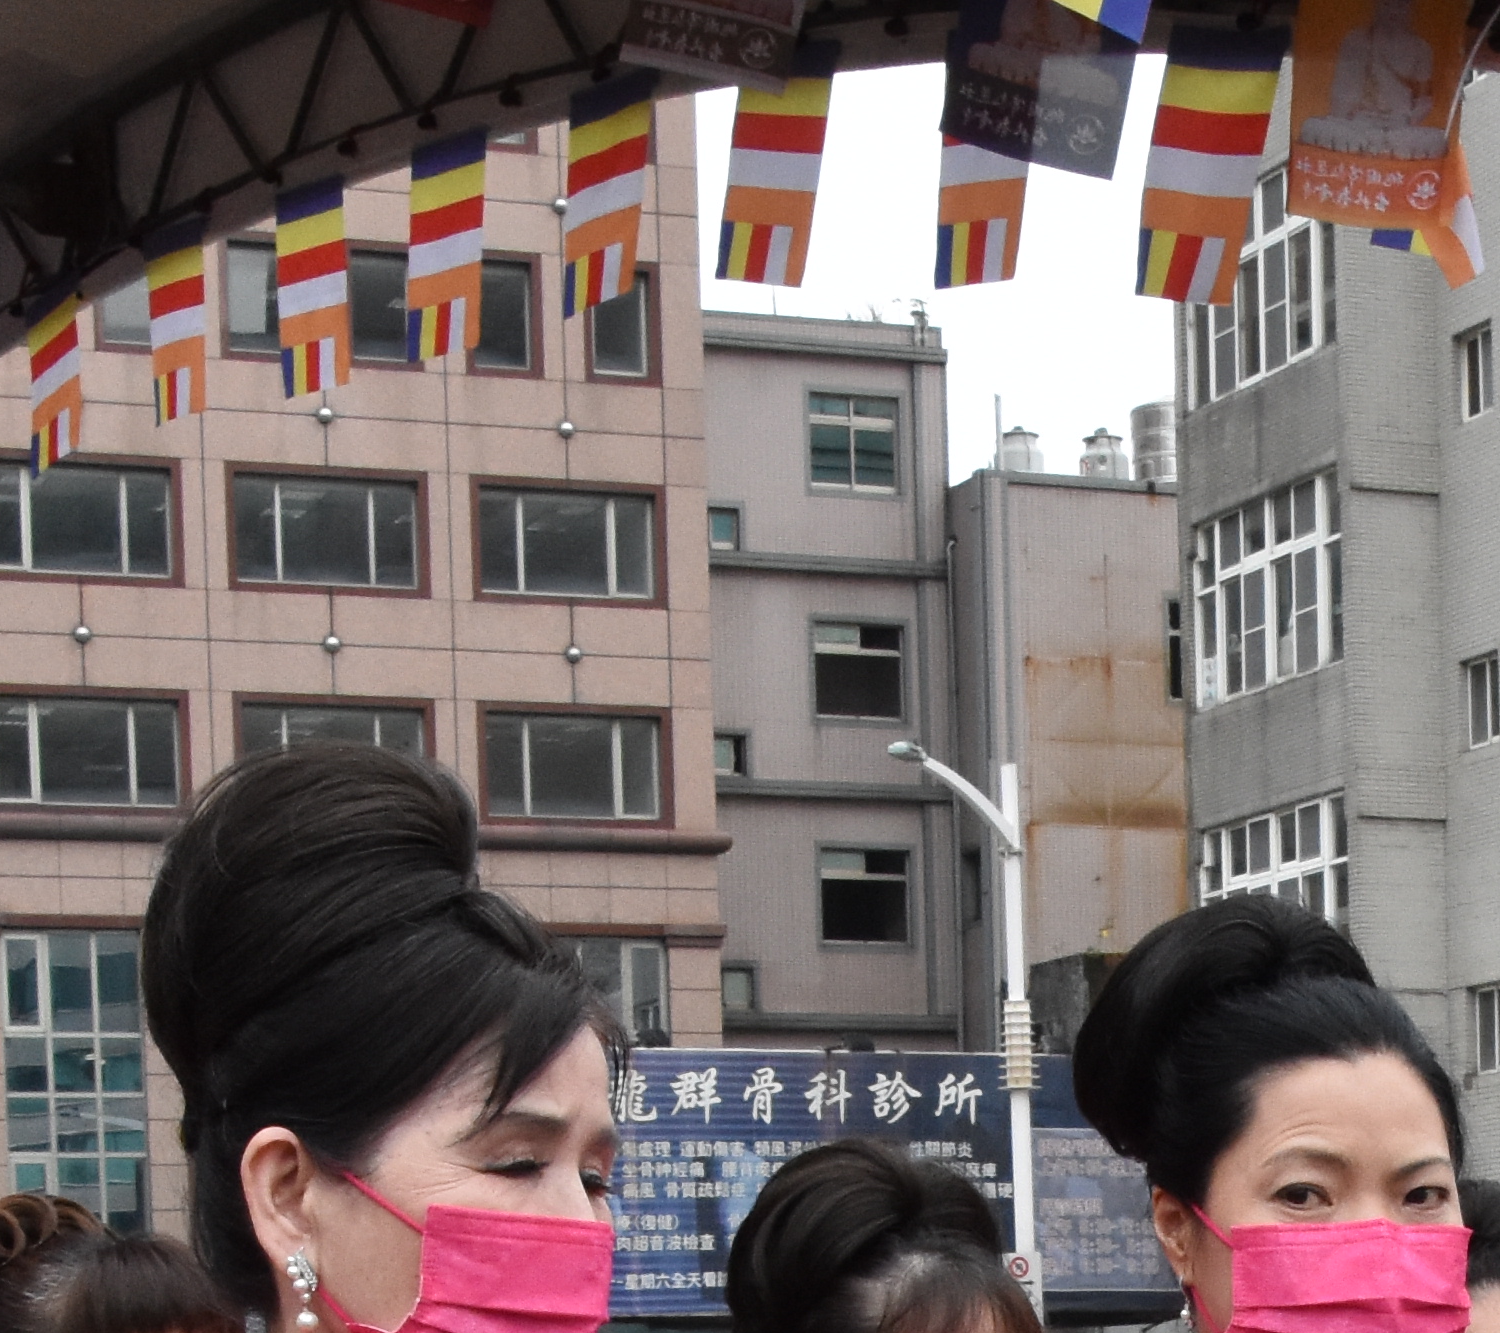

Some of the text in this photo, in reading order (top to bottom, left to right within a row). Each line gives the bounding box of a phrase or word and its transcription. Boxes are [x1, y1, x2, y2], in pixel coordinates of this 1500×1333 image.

[613, 1067, 984, 1124] 龍群骨科診所
